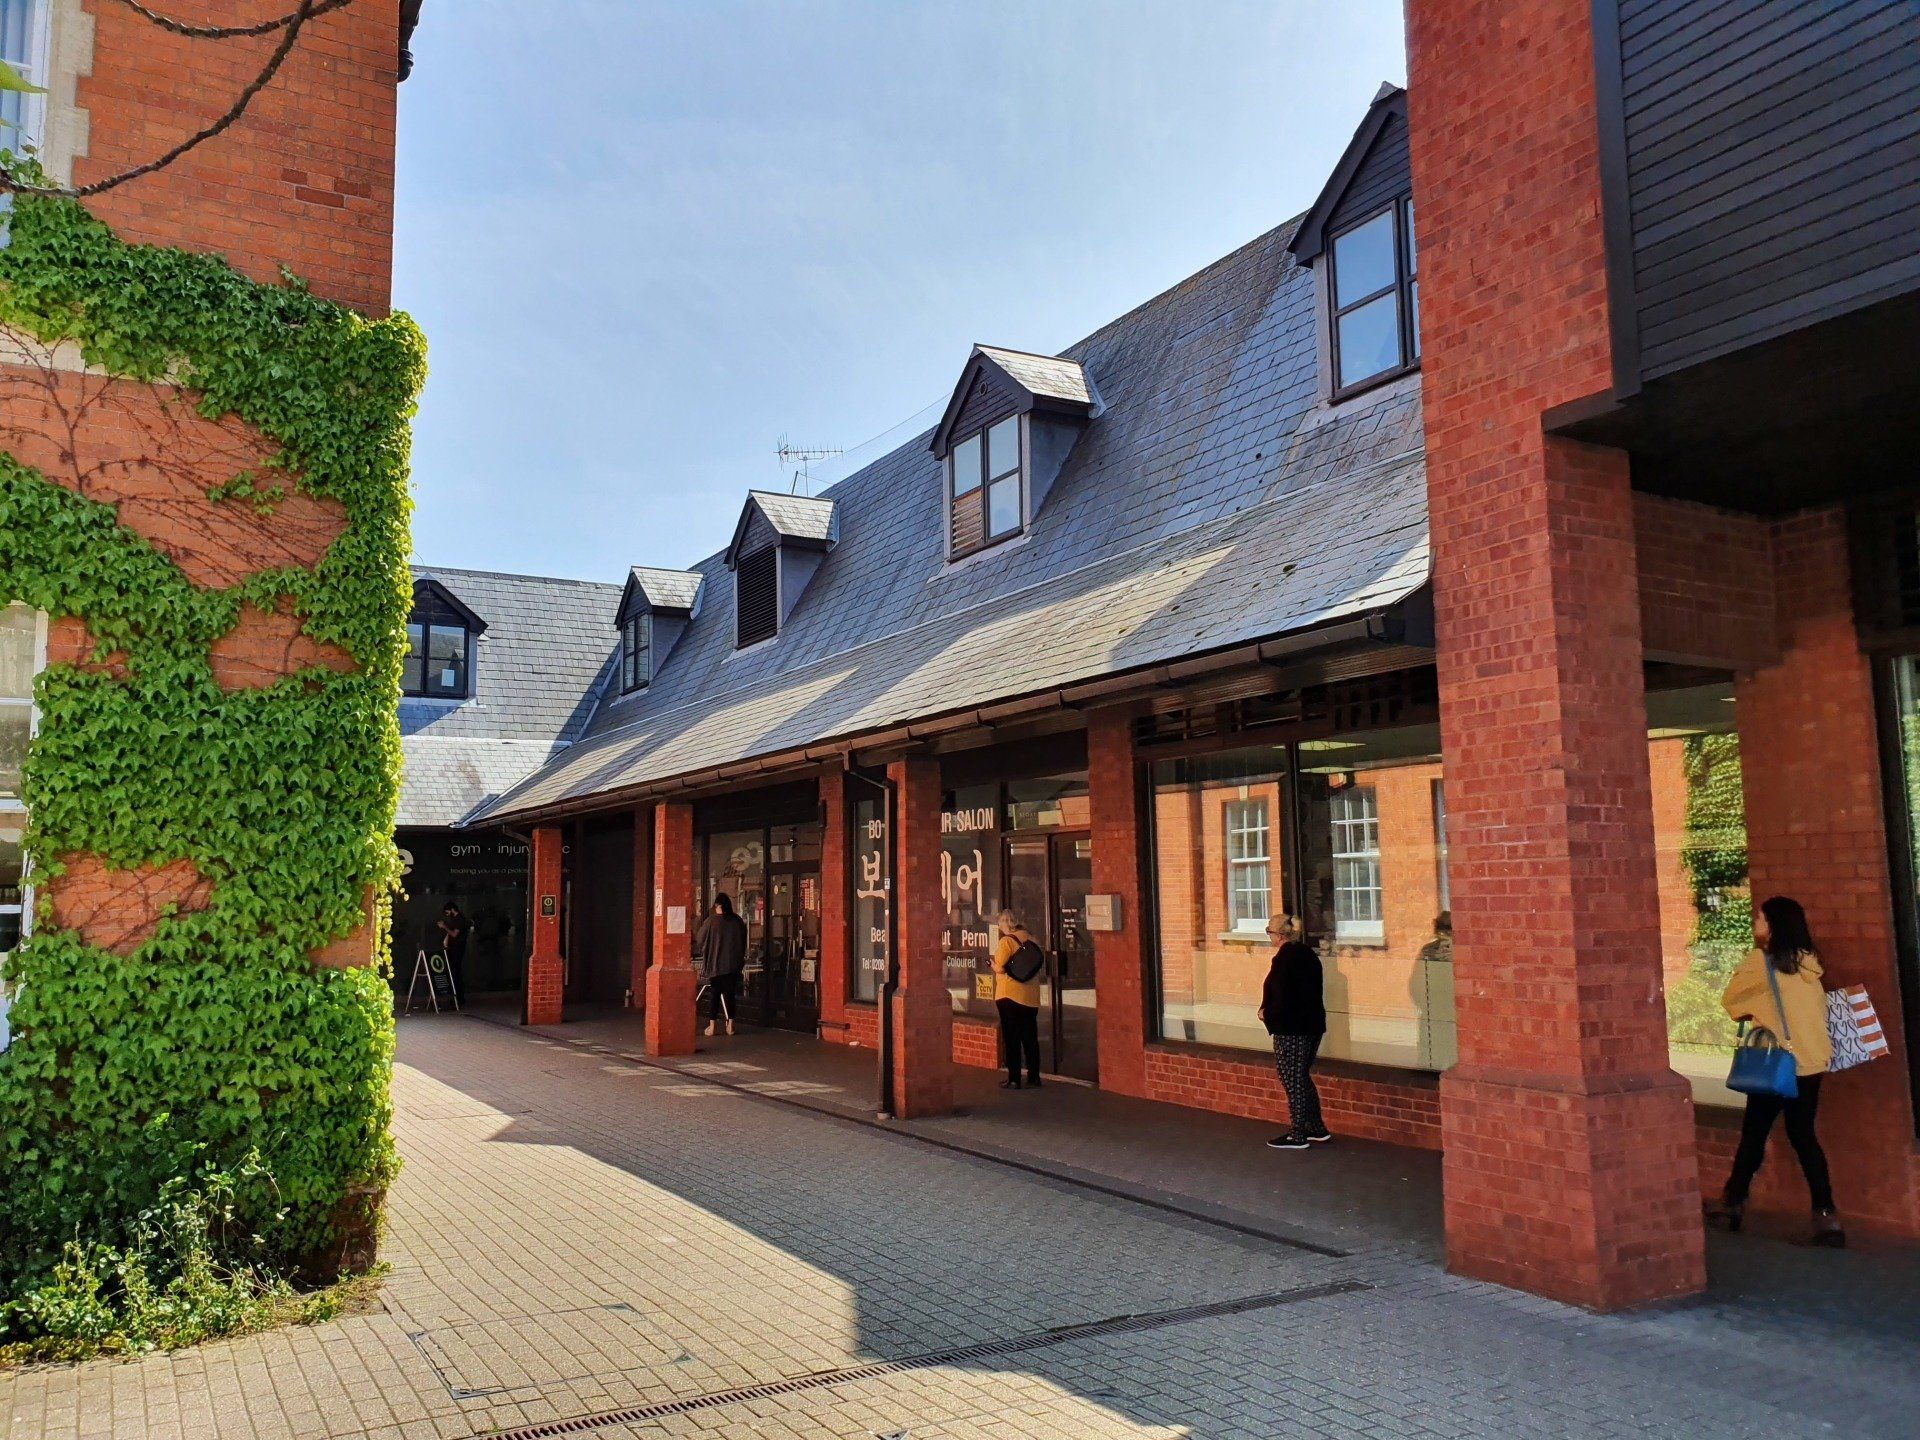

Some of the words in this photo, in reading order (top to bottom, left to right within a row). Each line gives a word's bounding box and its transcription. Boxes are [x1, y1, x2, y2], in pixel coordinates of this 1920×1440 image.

[868, 820, 882, 839] BO
[940, 812, 952, 834] IR
[956, 808, 994, 832] SALON
[451, 845, 480, 857] gym
[857, 850, 886, 899] 보
[870, 927, 886, 943] Bea
[961, 929, 989, 948] Perm
[946, 956, 976, 969] Coloured
